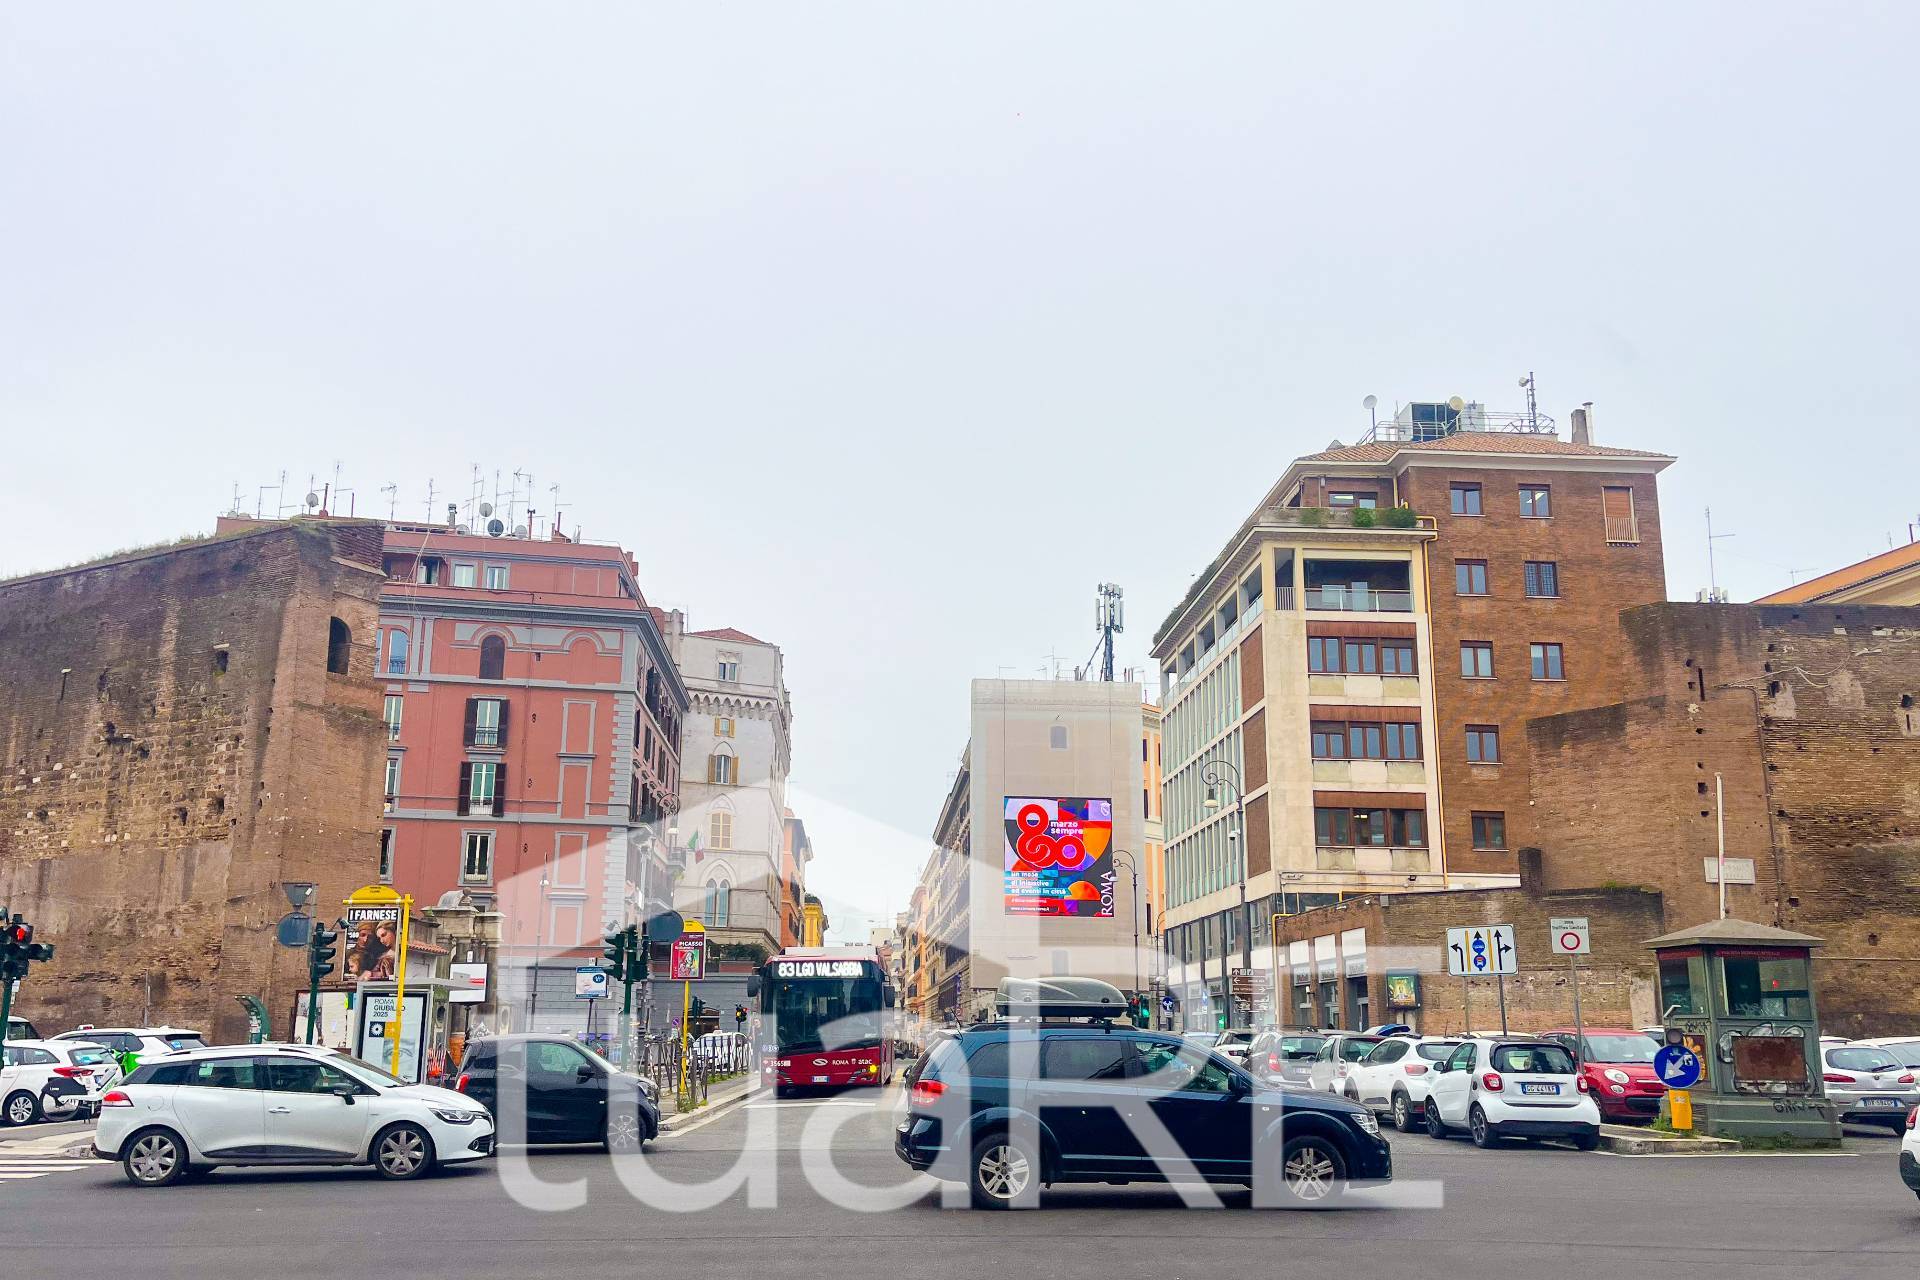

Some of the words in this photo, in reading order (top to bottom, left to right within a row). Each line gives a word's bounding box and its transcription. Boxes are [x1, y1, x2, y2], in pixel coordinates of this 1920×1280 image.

[1101, 870, 1113, 915] ROMA
[349, 909, 354, 921] I
[355, 909, 397, 921] FARNESE
[778, 962, 795, 977] 83
[816, 961, 863, 977] VALSABBIA
